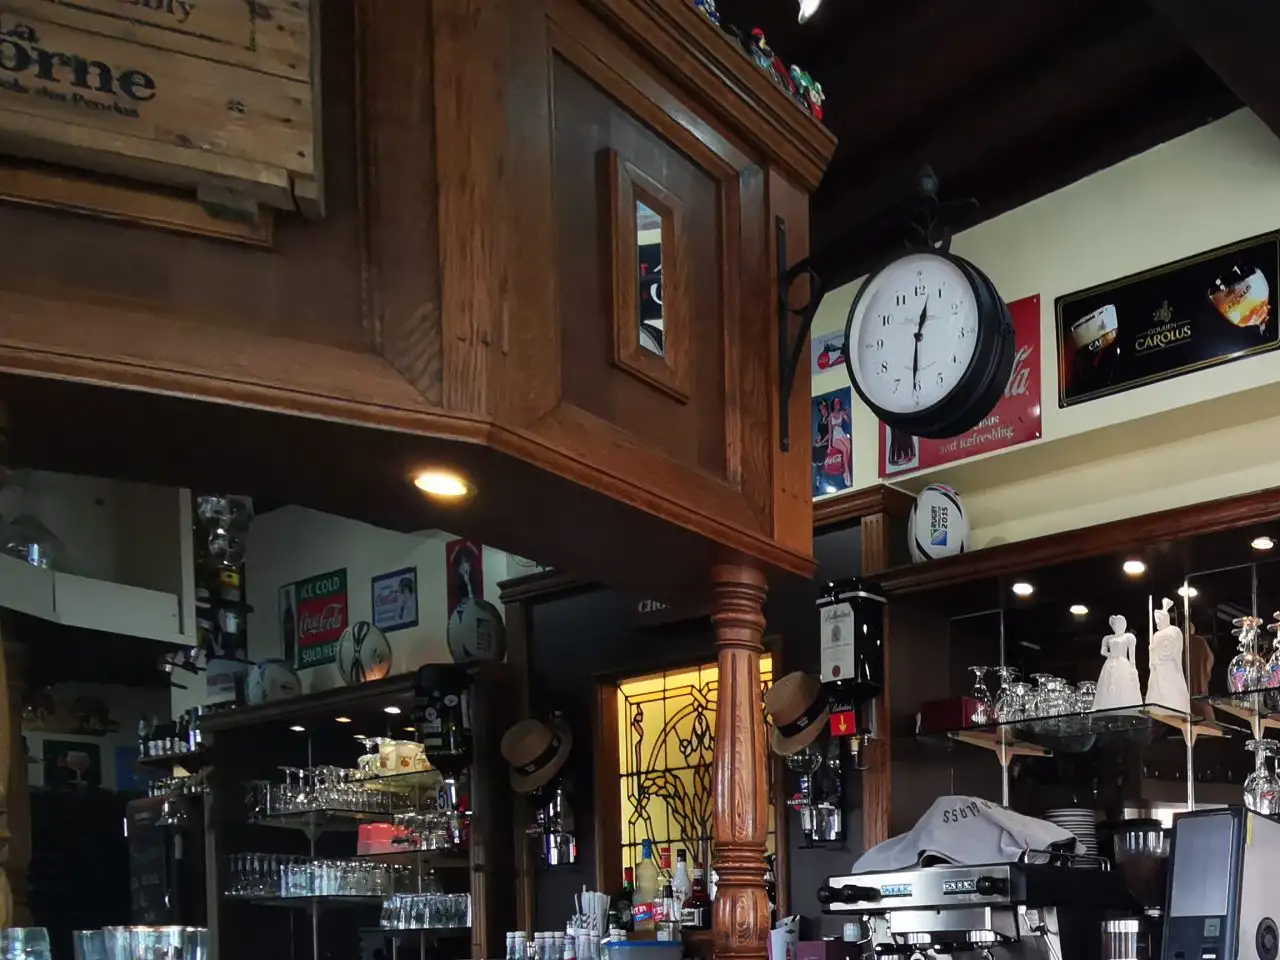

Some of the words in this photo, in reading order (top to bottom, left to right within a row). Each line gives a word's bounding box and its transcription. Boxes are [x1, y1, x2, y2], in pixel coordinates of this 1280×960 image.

[0, 37, 157, 101] orne
[1134, 325, 1192, 351] CAROLUS
[941, 506, 949, 529] 2015
